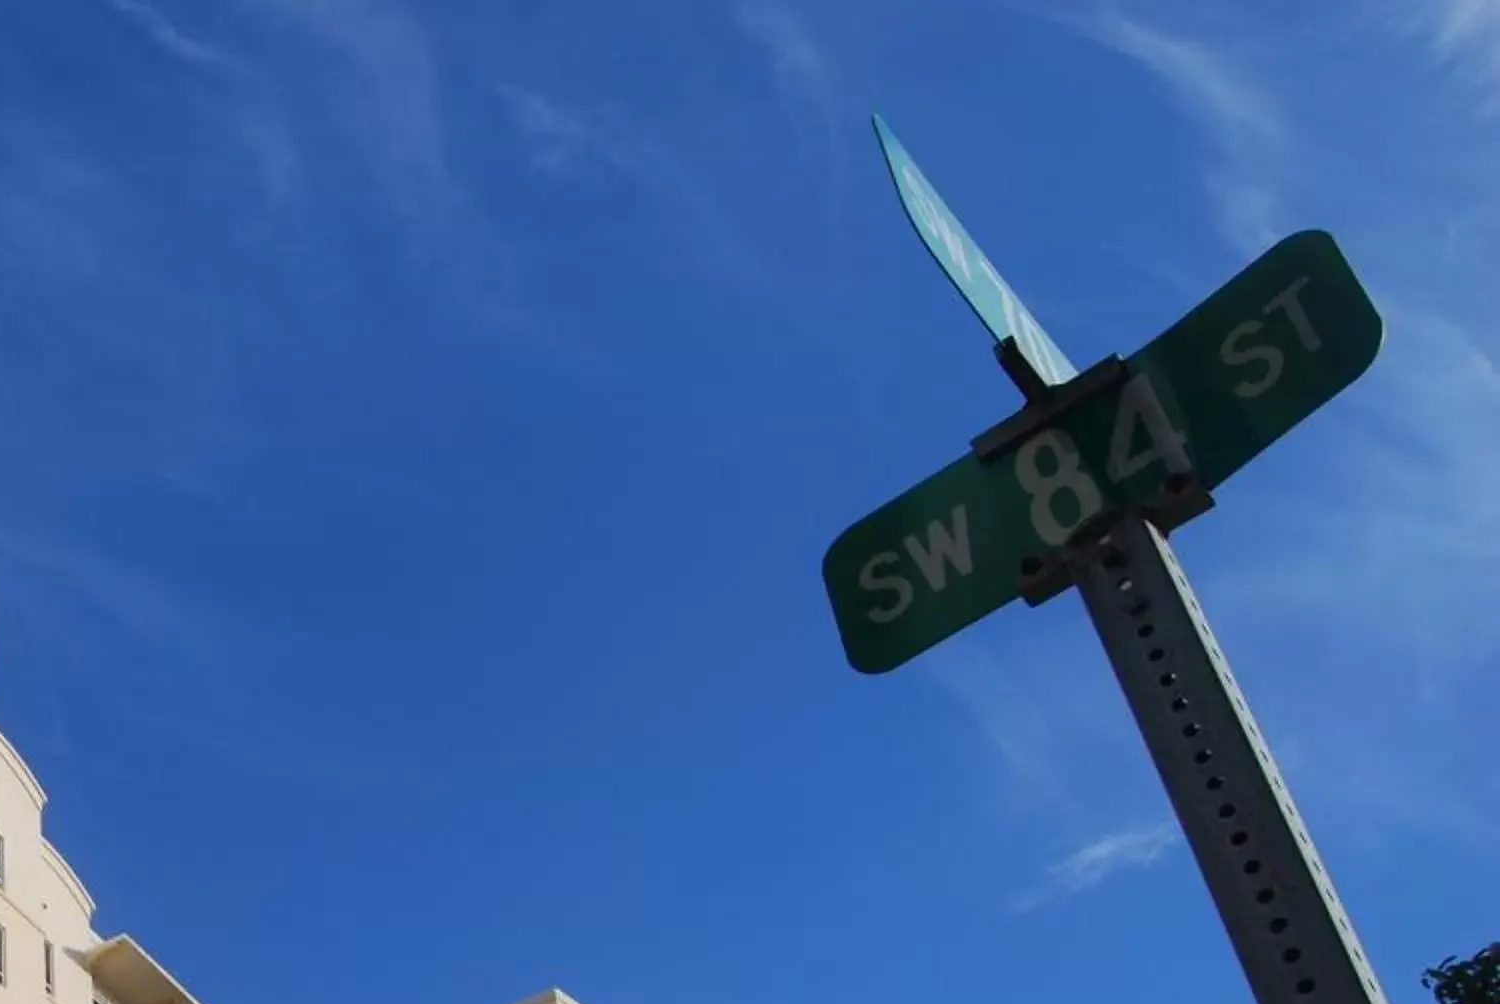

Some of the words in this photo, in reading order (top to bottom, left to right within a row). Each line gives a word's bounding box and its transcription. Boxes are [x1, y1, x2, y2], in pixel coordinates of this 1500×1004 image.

[859, 504, 974, 623] SW
[1014, 372, 1193, 546] 84
[1219, 276, 1322, 398] ST
